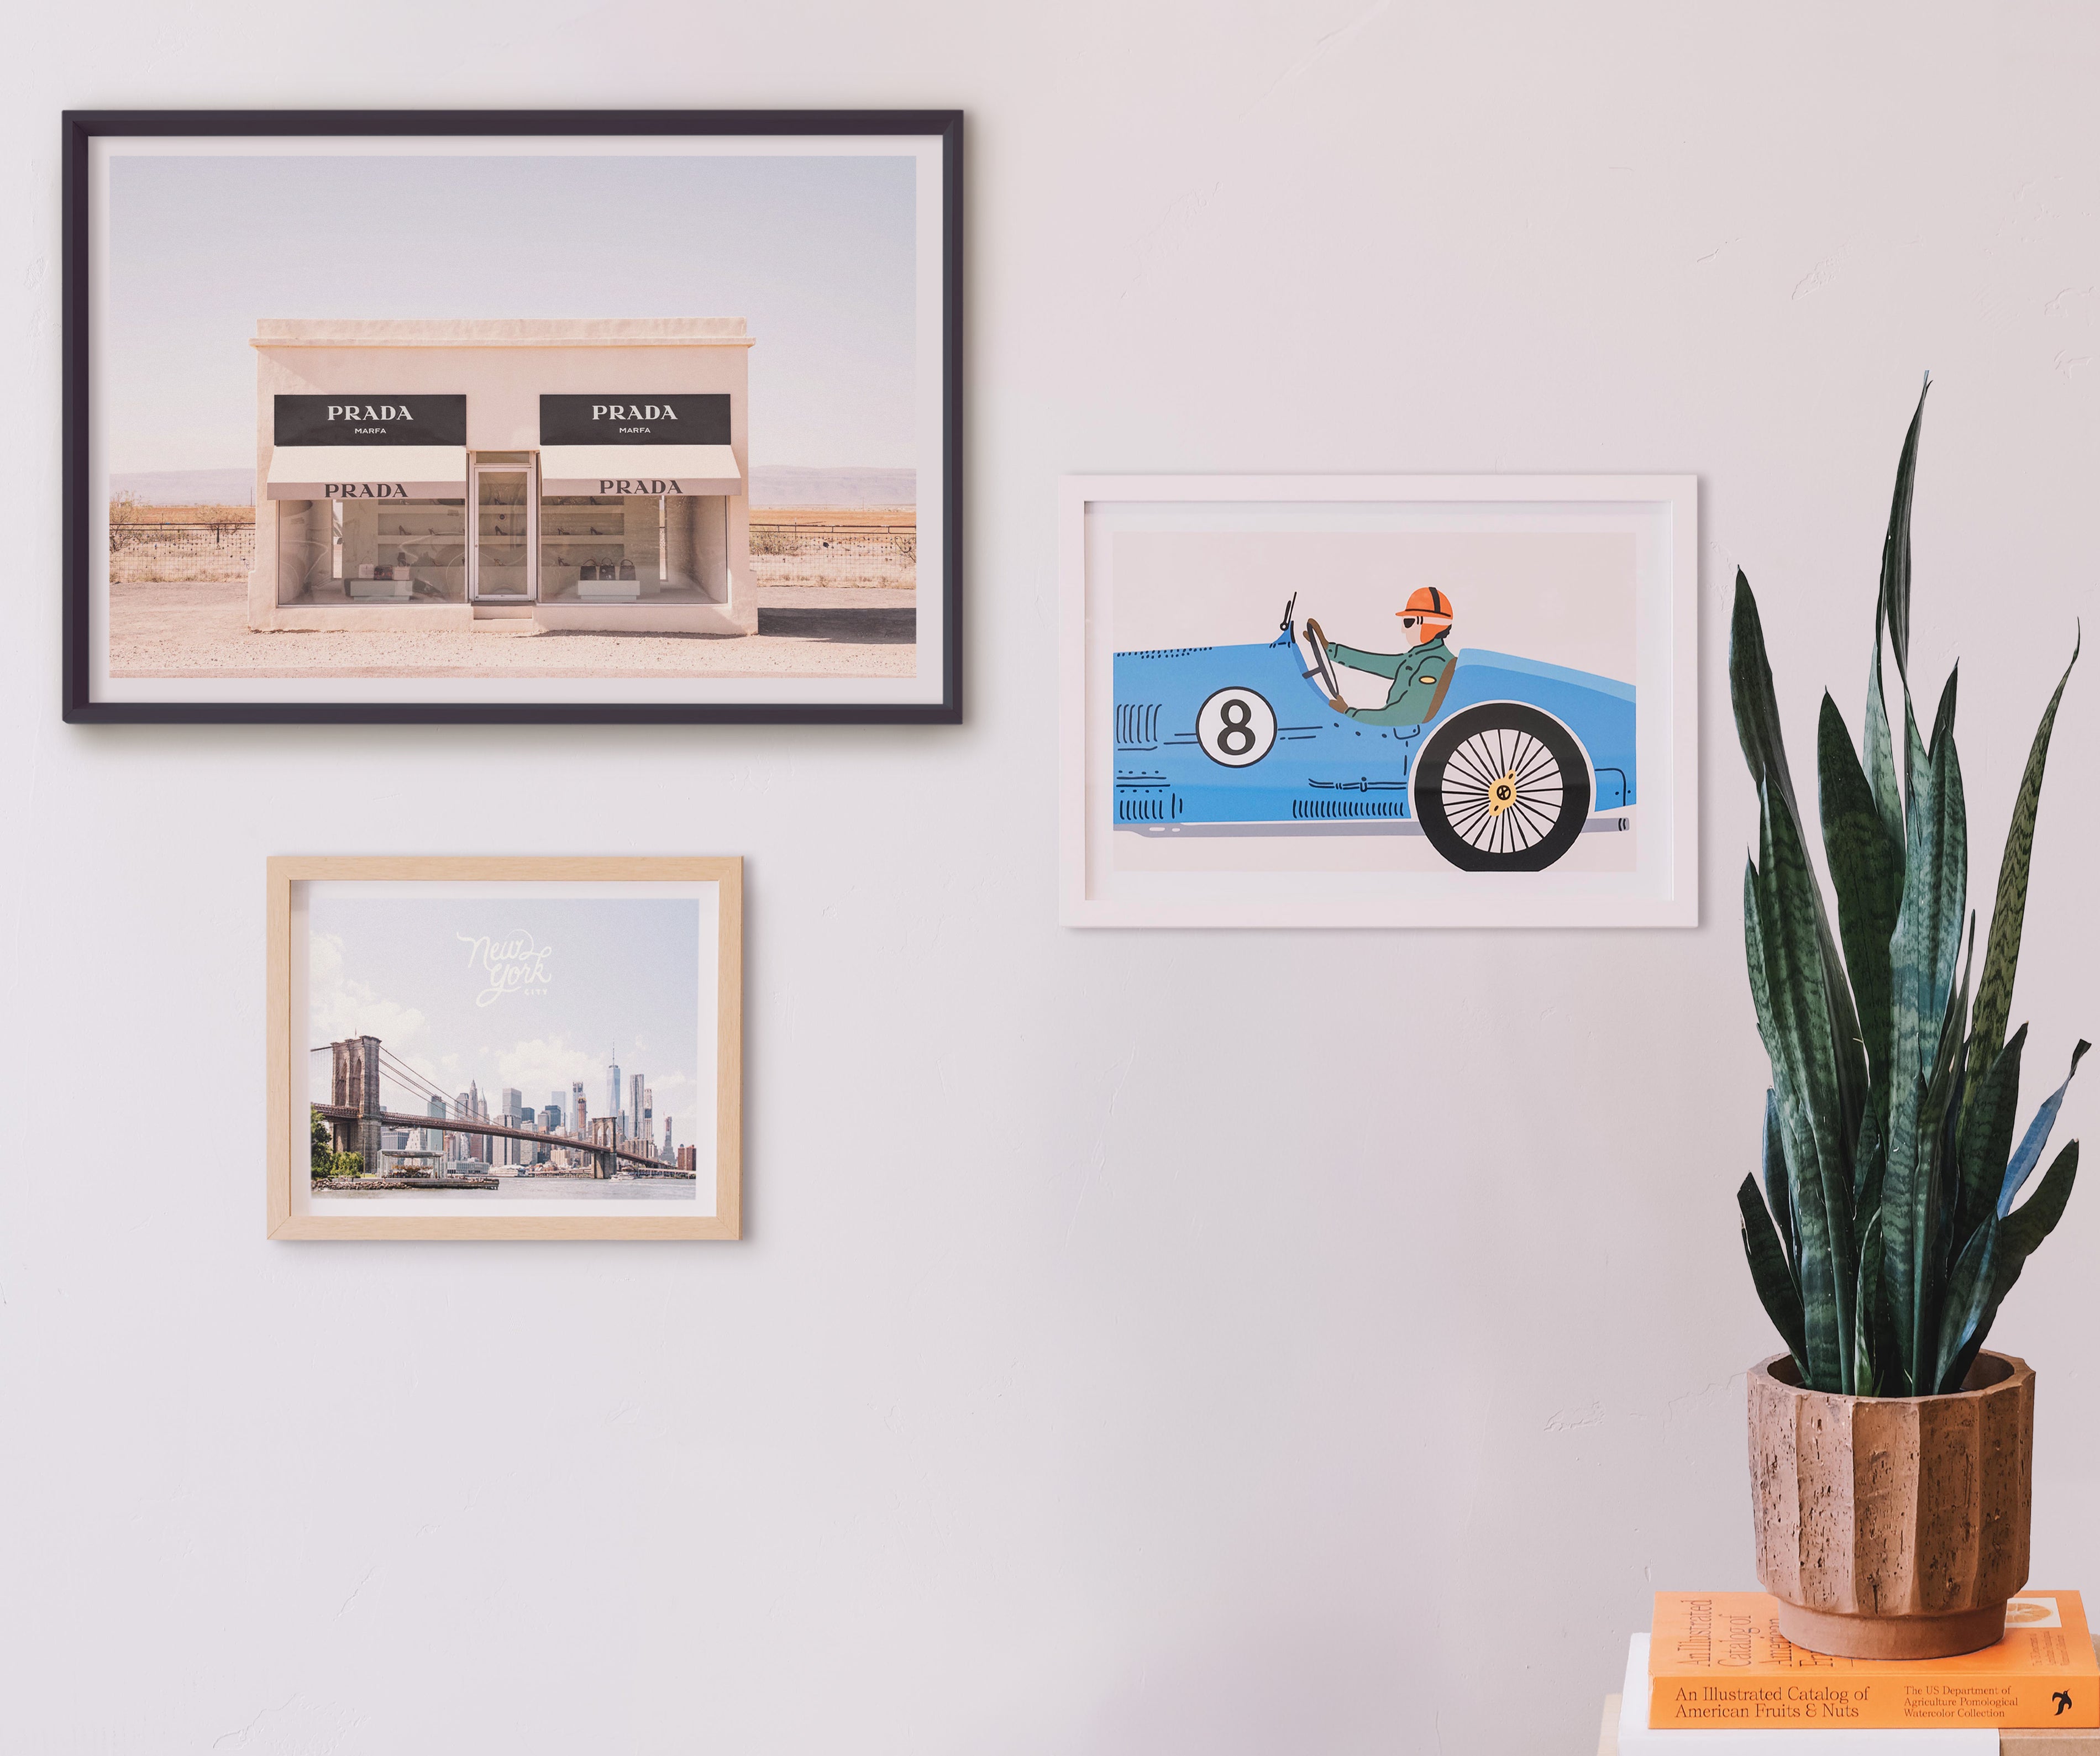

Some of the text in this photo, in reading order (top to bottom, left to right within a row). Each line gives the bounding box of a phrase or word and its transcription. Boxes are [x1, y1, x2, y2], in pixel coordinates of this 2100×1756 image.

[327, 406, 414, 420] PRADA
[592, 405, 678, 420] PRADA
[324, 483, 408, 498] PRADA
[600, 480, 683, 494] PRADA
[1217, 699, 1256, 755] 8
[1677, 1600, 1712, 1667] An Illustrated
[1718, 1615, 1761, 1666] Catalog of
[1675, 1686, 1870, 1704] An Illustrated Catalog of
[1904, 1686, 2012, 1696] The US Department of
[1904, 1697, 2018, 1708] Agriculture Pomological
[1675, 1703, 1859, 1718] American Fruits & Nuts
[1904, 1708, 2005, 1717] Watercolor Collection
